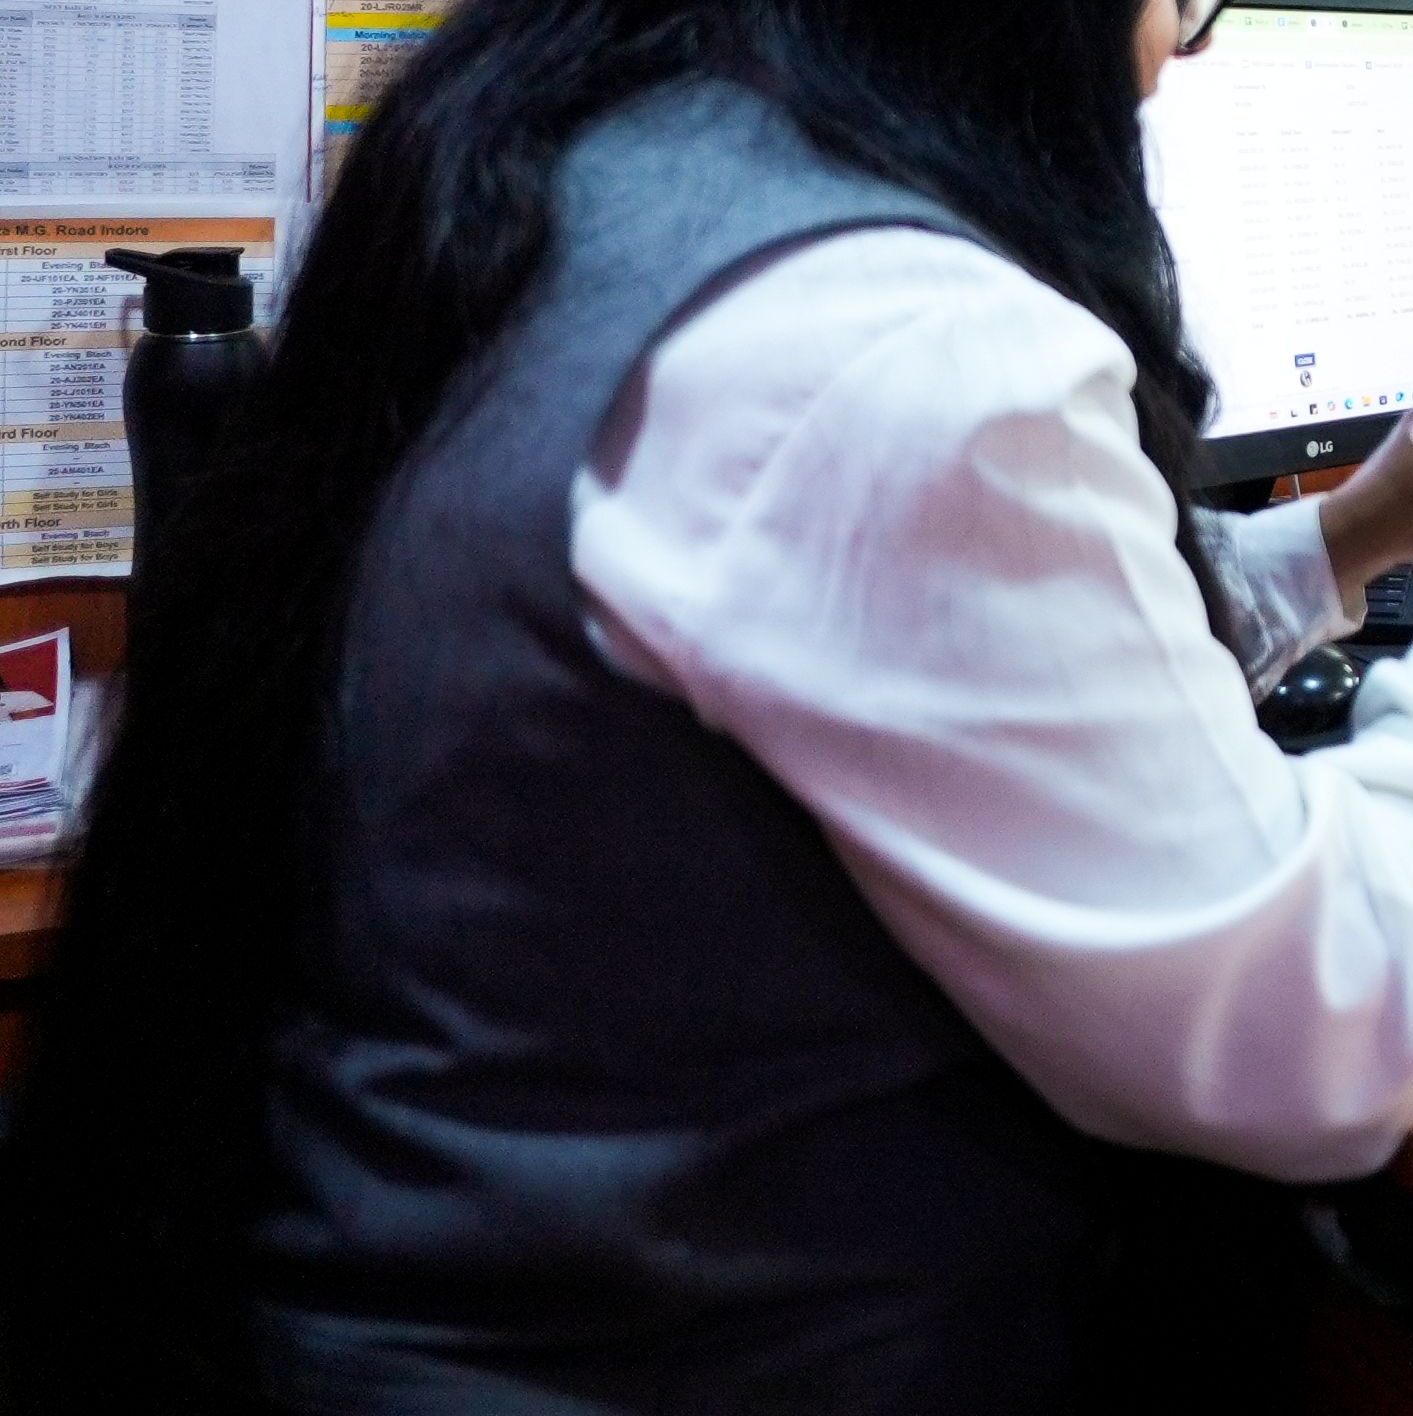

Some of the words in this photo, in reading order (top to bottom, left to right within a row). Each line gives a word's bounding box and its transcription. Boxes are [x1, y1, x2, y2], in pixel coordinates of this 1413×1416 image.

[56, 224, 96, 236] Road
[101, 224, 150, 236] Indore
[22, 245, 58, 256] Floor
[30, 336, 67, 347] Floor
[21, 427, 60, 439] Floor
[1319, 440, 1335, 454] LG
[24, 517, 62, 529] Floor
